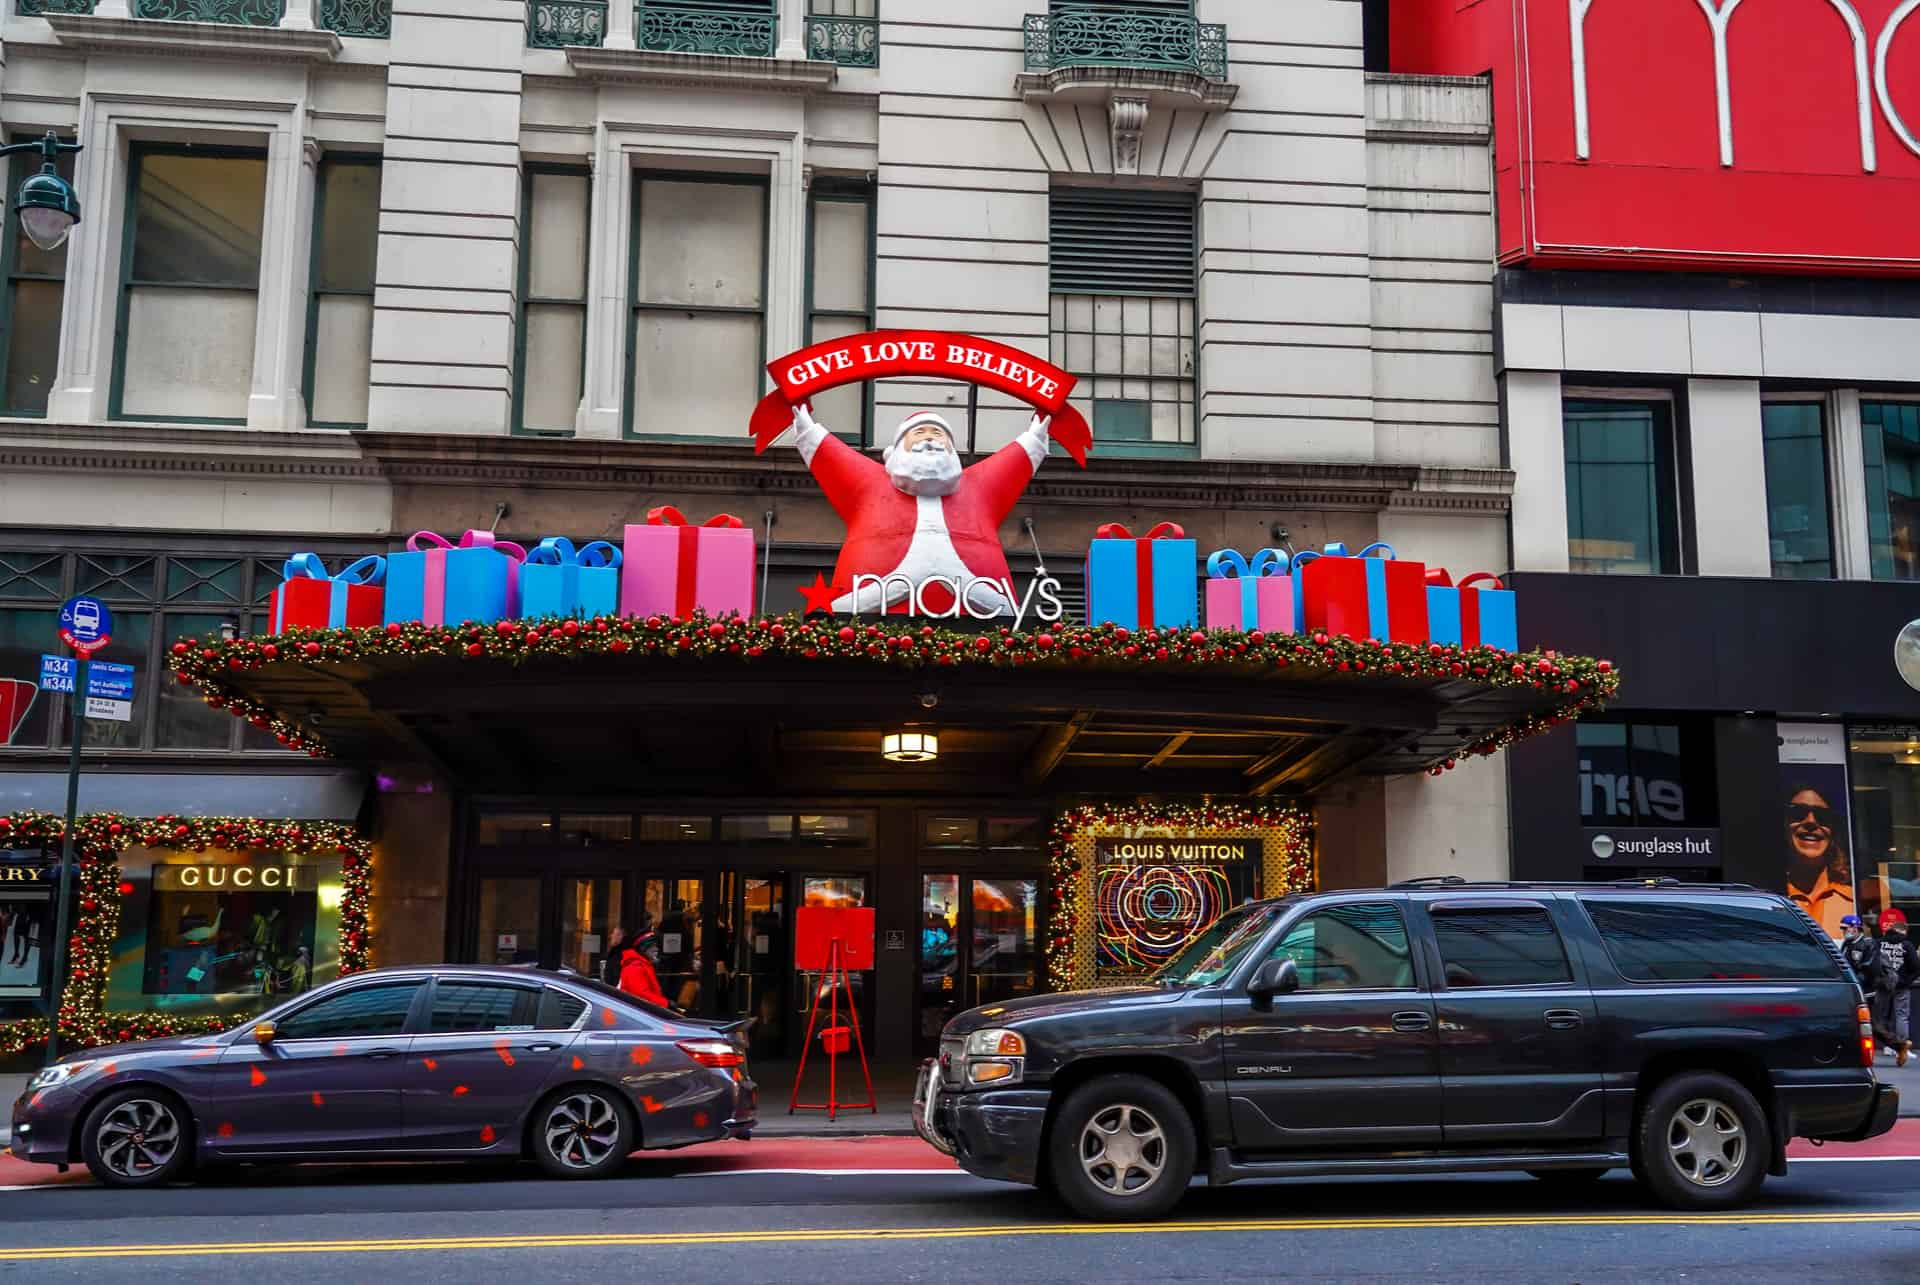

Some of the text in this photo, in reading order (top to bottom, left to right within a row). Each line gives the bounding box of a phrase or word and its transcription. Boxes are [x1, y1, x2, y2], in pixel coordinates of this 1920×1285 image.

[787, 342, 1059, 398] GIVE LOVE BELIEVE
[44, 660, 68, 673] M34
[42, 677, 74, 691] M34A
[1114, 844, 1244, 860] LOUIS VUITTON
[1617, 838, 1712, 857] sunglass hut
[180, 867, 297, 887] GUCCI
[1236, 1066, 1292, 1074] DENALI
